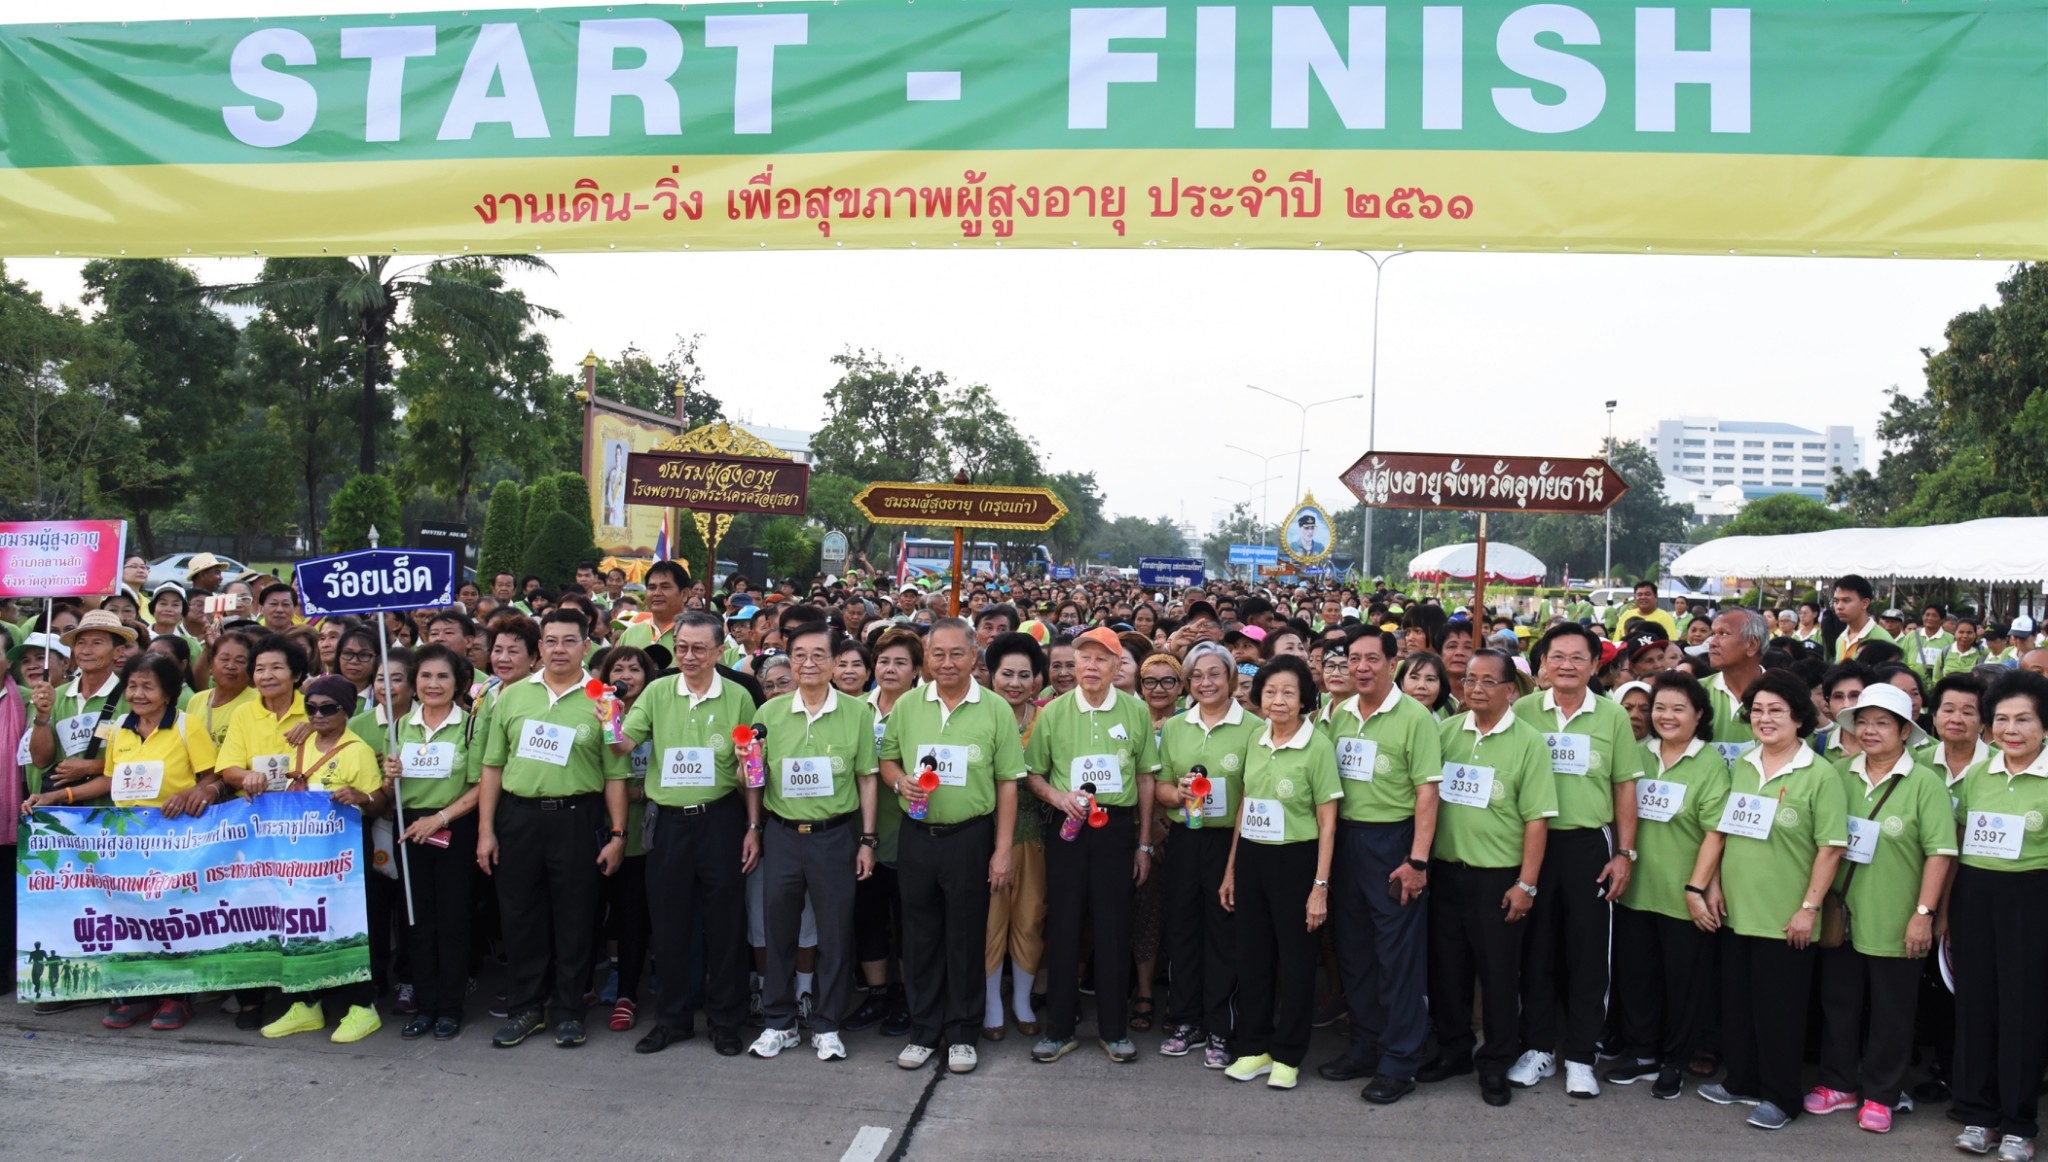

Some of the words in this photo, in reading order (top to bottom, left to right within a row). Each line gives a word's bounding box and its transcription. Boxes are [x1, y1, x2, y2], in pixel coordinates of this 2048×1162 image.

[221, 13, 808, 148] START
[1067, 3, 1751, 134] FINISH
[474, 165, 703, 224] งานเดิน-วิ่ง
[727, 164, 1126, 237] เพื่อสุขภาพผู้สูงอายุ
[1149, 169, 1321, 219] ประจำปี
[1345, 186, 1474, 220] ๒๕๖๑
[658, 460, 779, 493] ชมรมผู้สูงอายุ
[1362, 456, 1604, 508] ผู้สูงอายุจังหวัดอุทัยธานี
[632, 479, 799, 509] โรงพยาบาลพระนครศรีอยุธยา
[884, 493, 973, 515] ชมรมผู้สูงอายุ
[979, 498, 1038, 516] (กรุงเก่า)
[323, 555, 432, 598] ร้อยเอ็ด
[70, 727, 95, 741] 440
[529, 736, 559, 751] 0006
[411, 756, 440, 766] 3683
[1341, 754, 1362, 767] 2211
[672, 763, 702, 774] 0002
[790, 773, 819, 785] 0008
[1082, 770, 1111, 782] 0009
[1450, 780, 1479, 794] 3333
[1641, 794, 1669, 808] 5343
[1246, 815, 1270, 827] 0004
[1732, 809, 1761, 824] 0012
[1973, 829, 2006, 843] 5397
